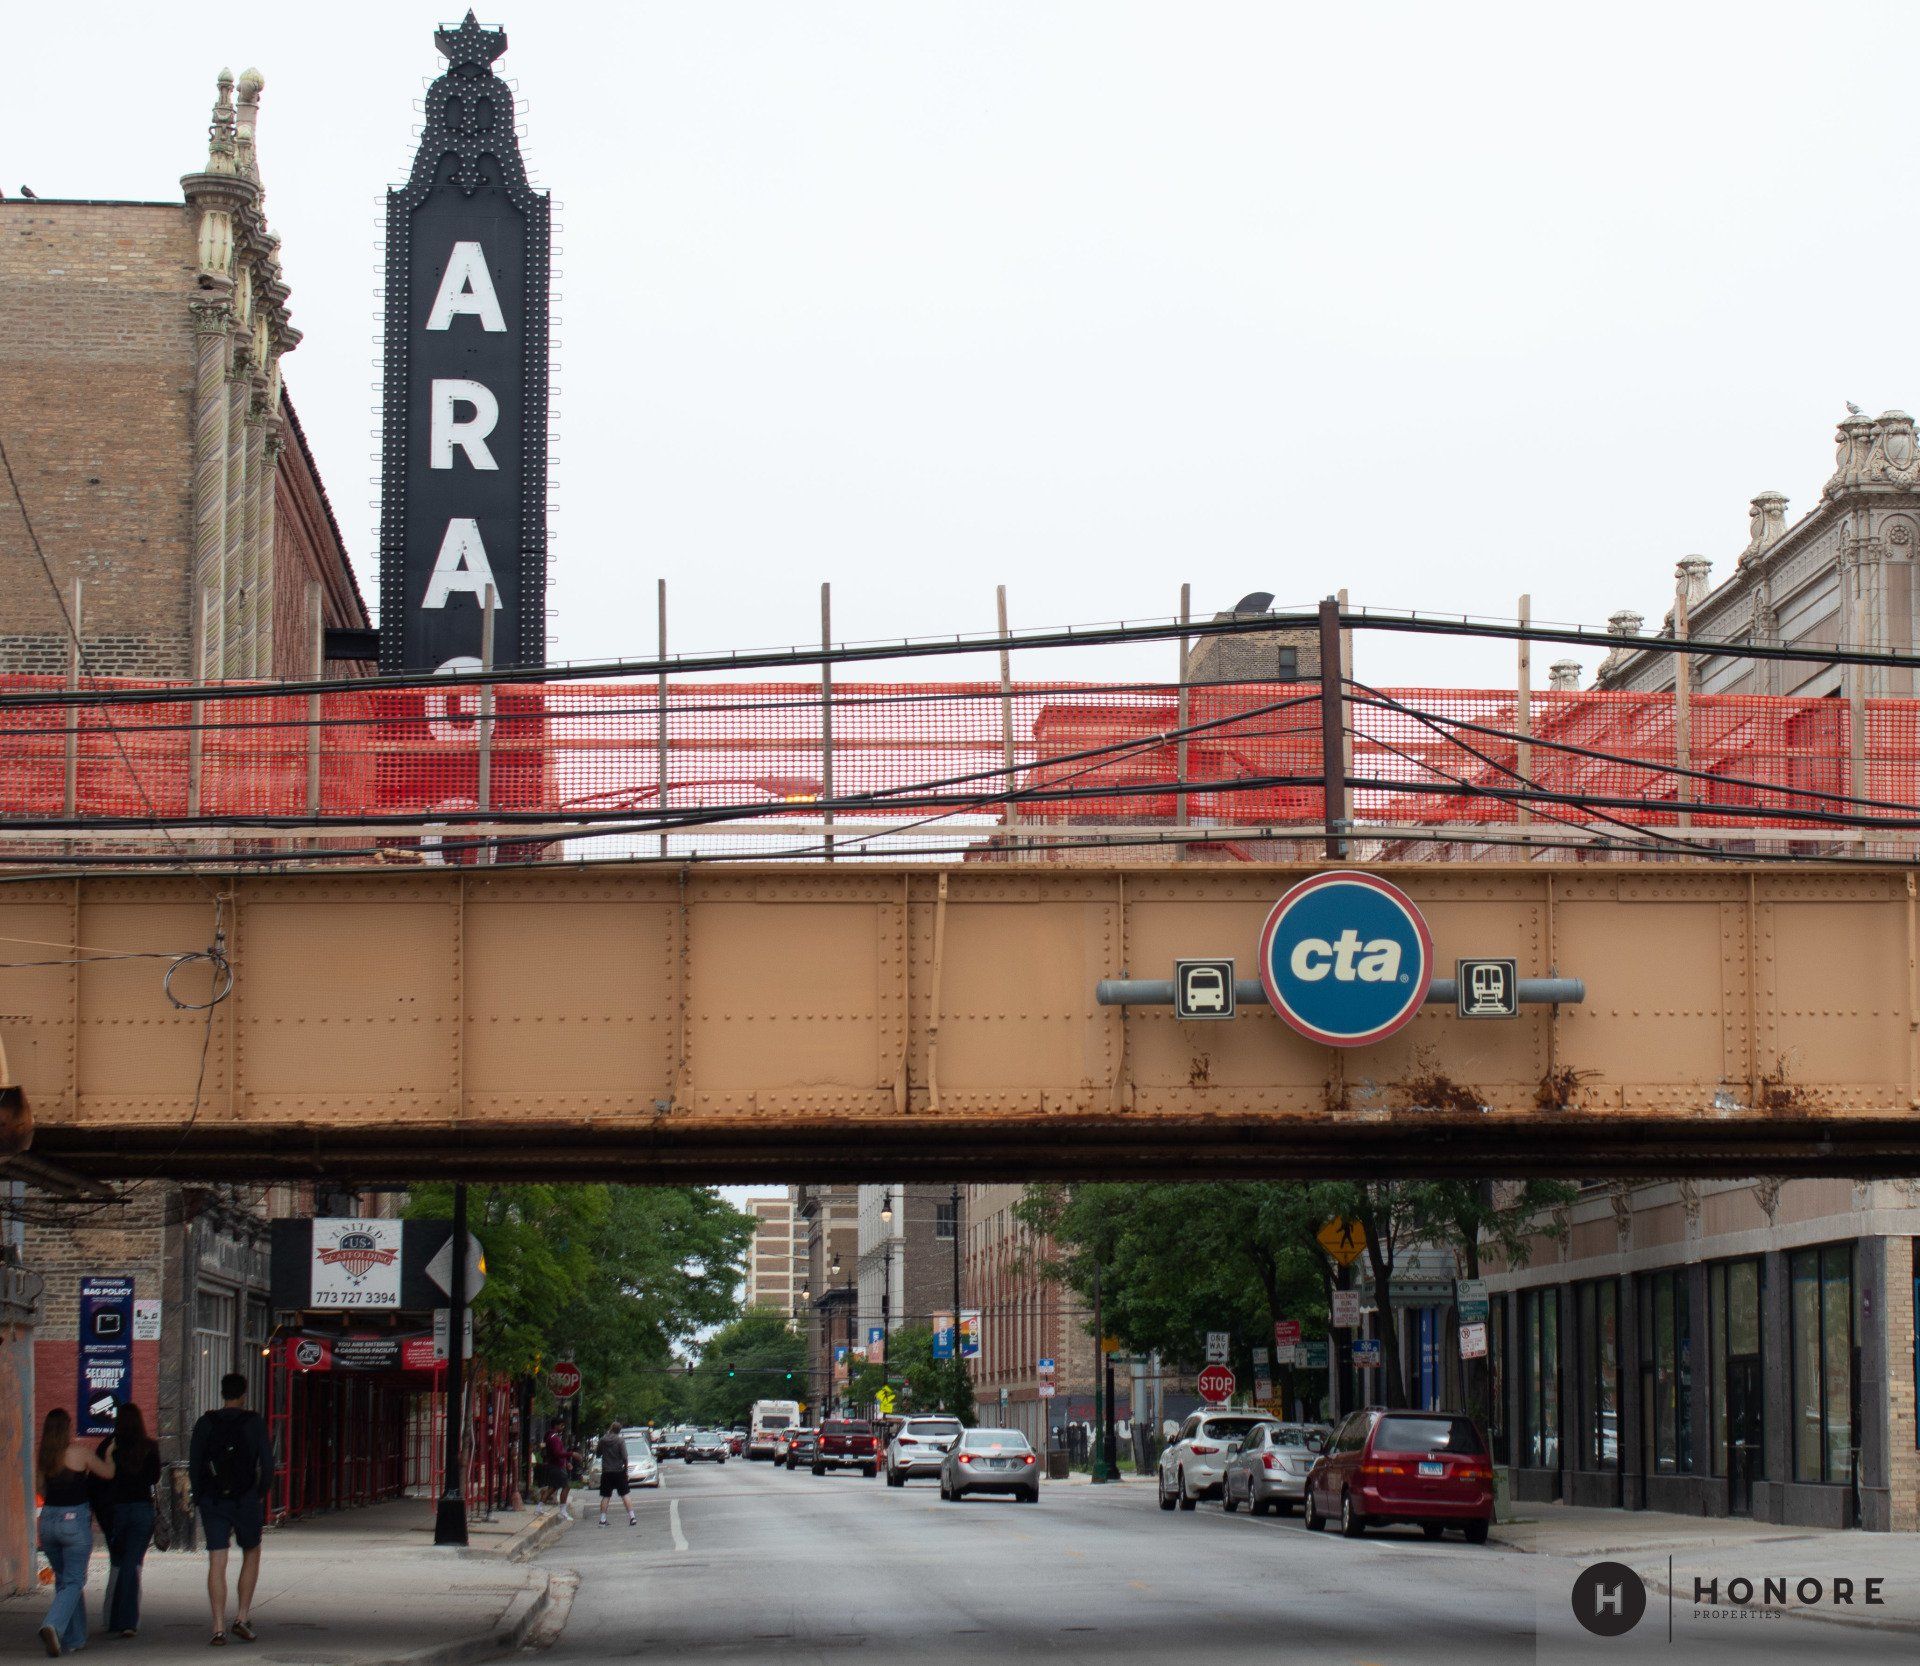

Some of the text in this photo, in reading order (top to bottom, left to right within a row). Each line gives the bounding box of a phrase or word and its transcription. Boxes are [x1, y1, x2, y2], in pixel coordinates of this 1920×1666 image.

[1290, 929, 1402, 982] cta
[332, 1223, 383, 1239] UNITED
[350, 1238, 367, 1248] US
[323, 1252, 391, 1264] SCAFFOLDING
[316, 1292, 396, 1304] 773 727 3394
[968, 1319, 979, 1345] PROUD
[86, 1368, 125, 1378] SECURITY
[91, 1379, 120, 1388] NOTICE
[1200, 1376, 1233, 1391] STOP
